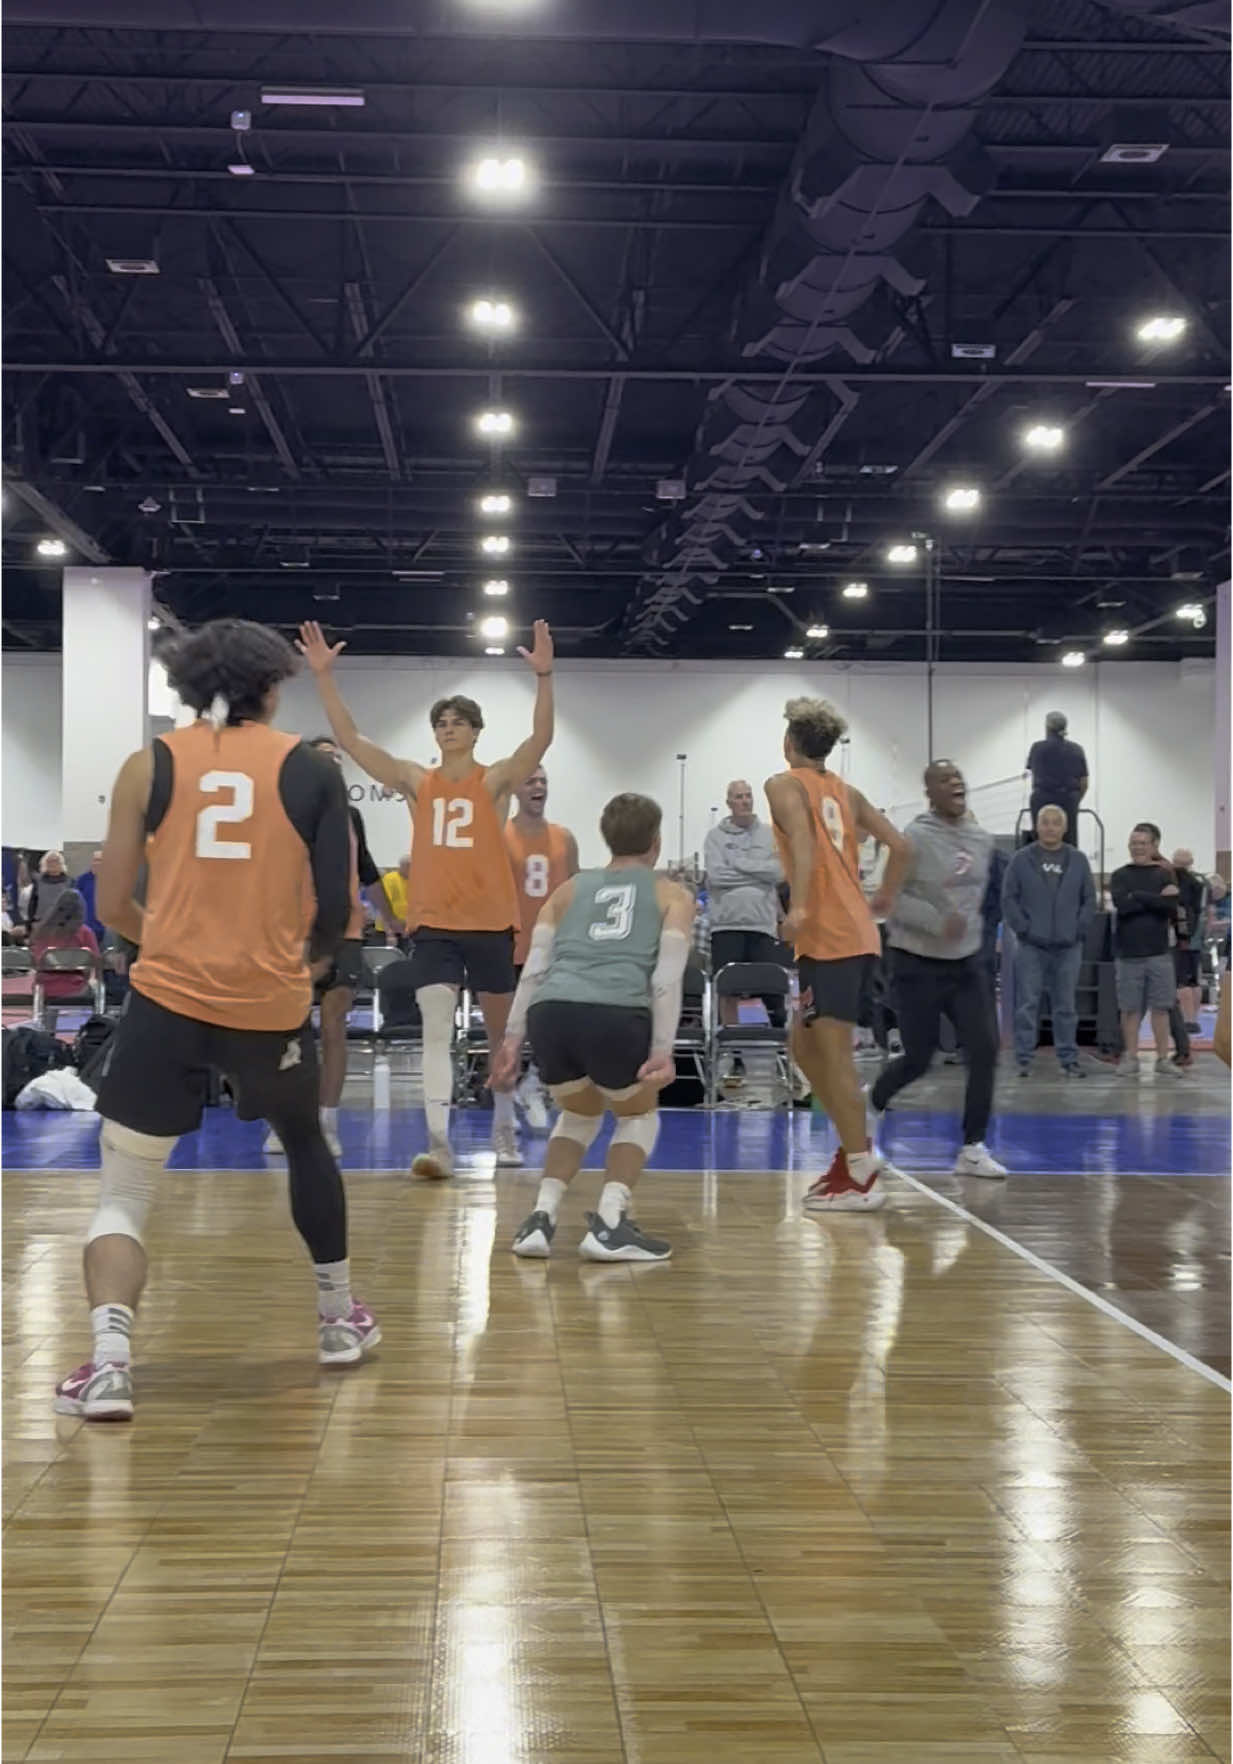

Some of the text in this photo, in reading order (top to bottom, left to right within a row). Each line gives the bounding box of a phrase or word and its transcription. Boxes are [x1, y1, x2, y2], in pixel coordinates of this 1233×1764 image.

[196, 770, 254, 860] 2
[432, 797, 474, 848] 12
[525, 853, 549, 898] 8
[589, 883, 637, 941] 3
